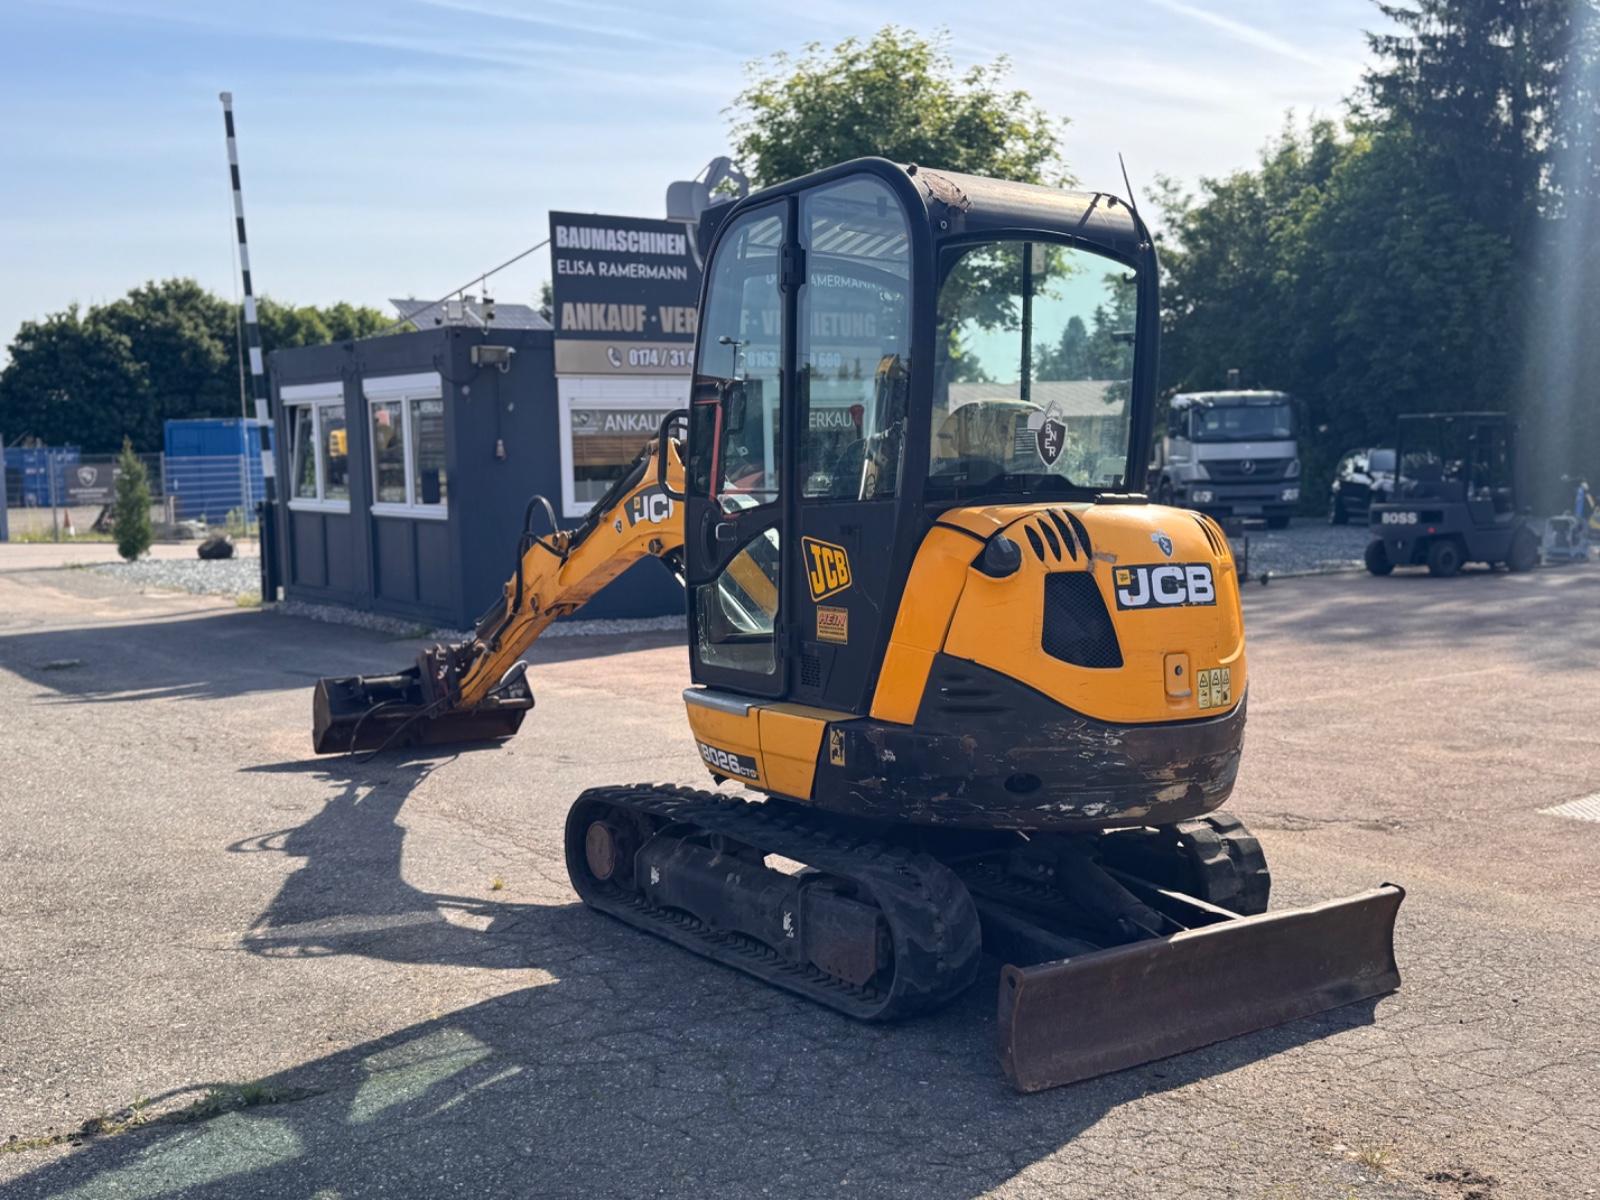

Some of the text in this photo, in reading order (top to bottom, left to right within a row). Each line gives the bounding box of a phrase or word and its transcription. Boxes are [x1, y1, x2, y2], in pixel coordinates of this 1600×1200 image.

[556, 225, 686, 255] BAUMASCHINEN
[557, 259, 687, 280] ELISA RAMERMANN
[561, 301, 647, 332] ANKAUF
[629, 348, 658, 367] 0174
[809, 411, 855, 429] ERKAU
[634, 493, 674, 524] JC
[1382, 511, 1417, 524] BOSS
[810, 543, 849, 594] JCB
[1118, 565, 1214, 606] JCB
